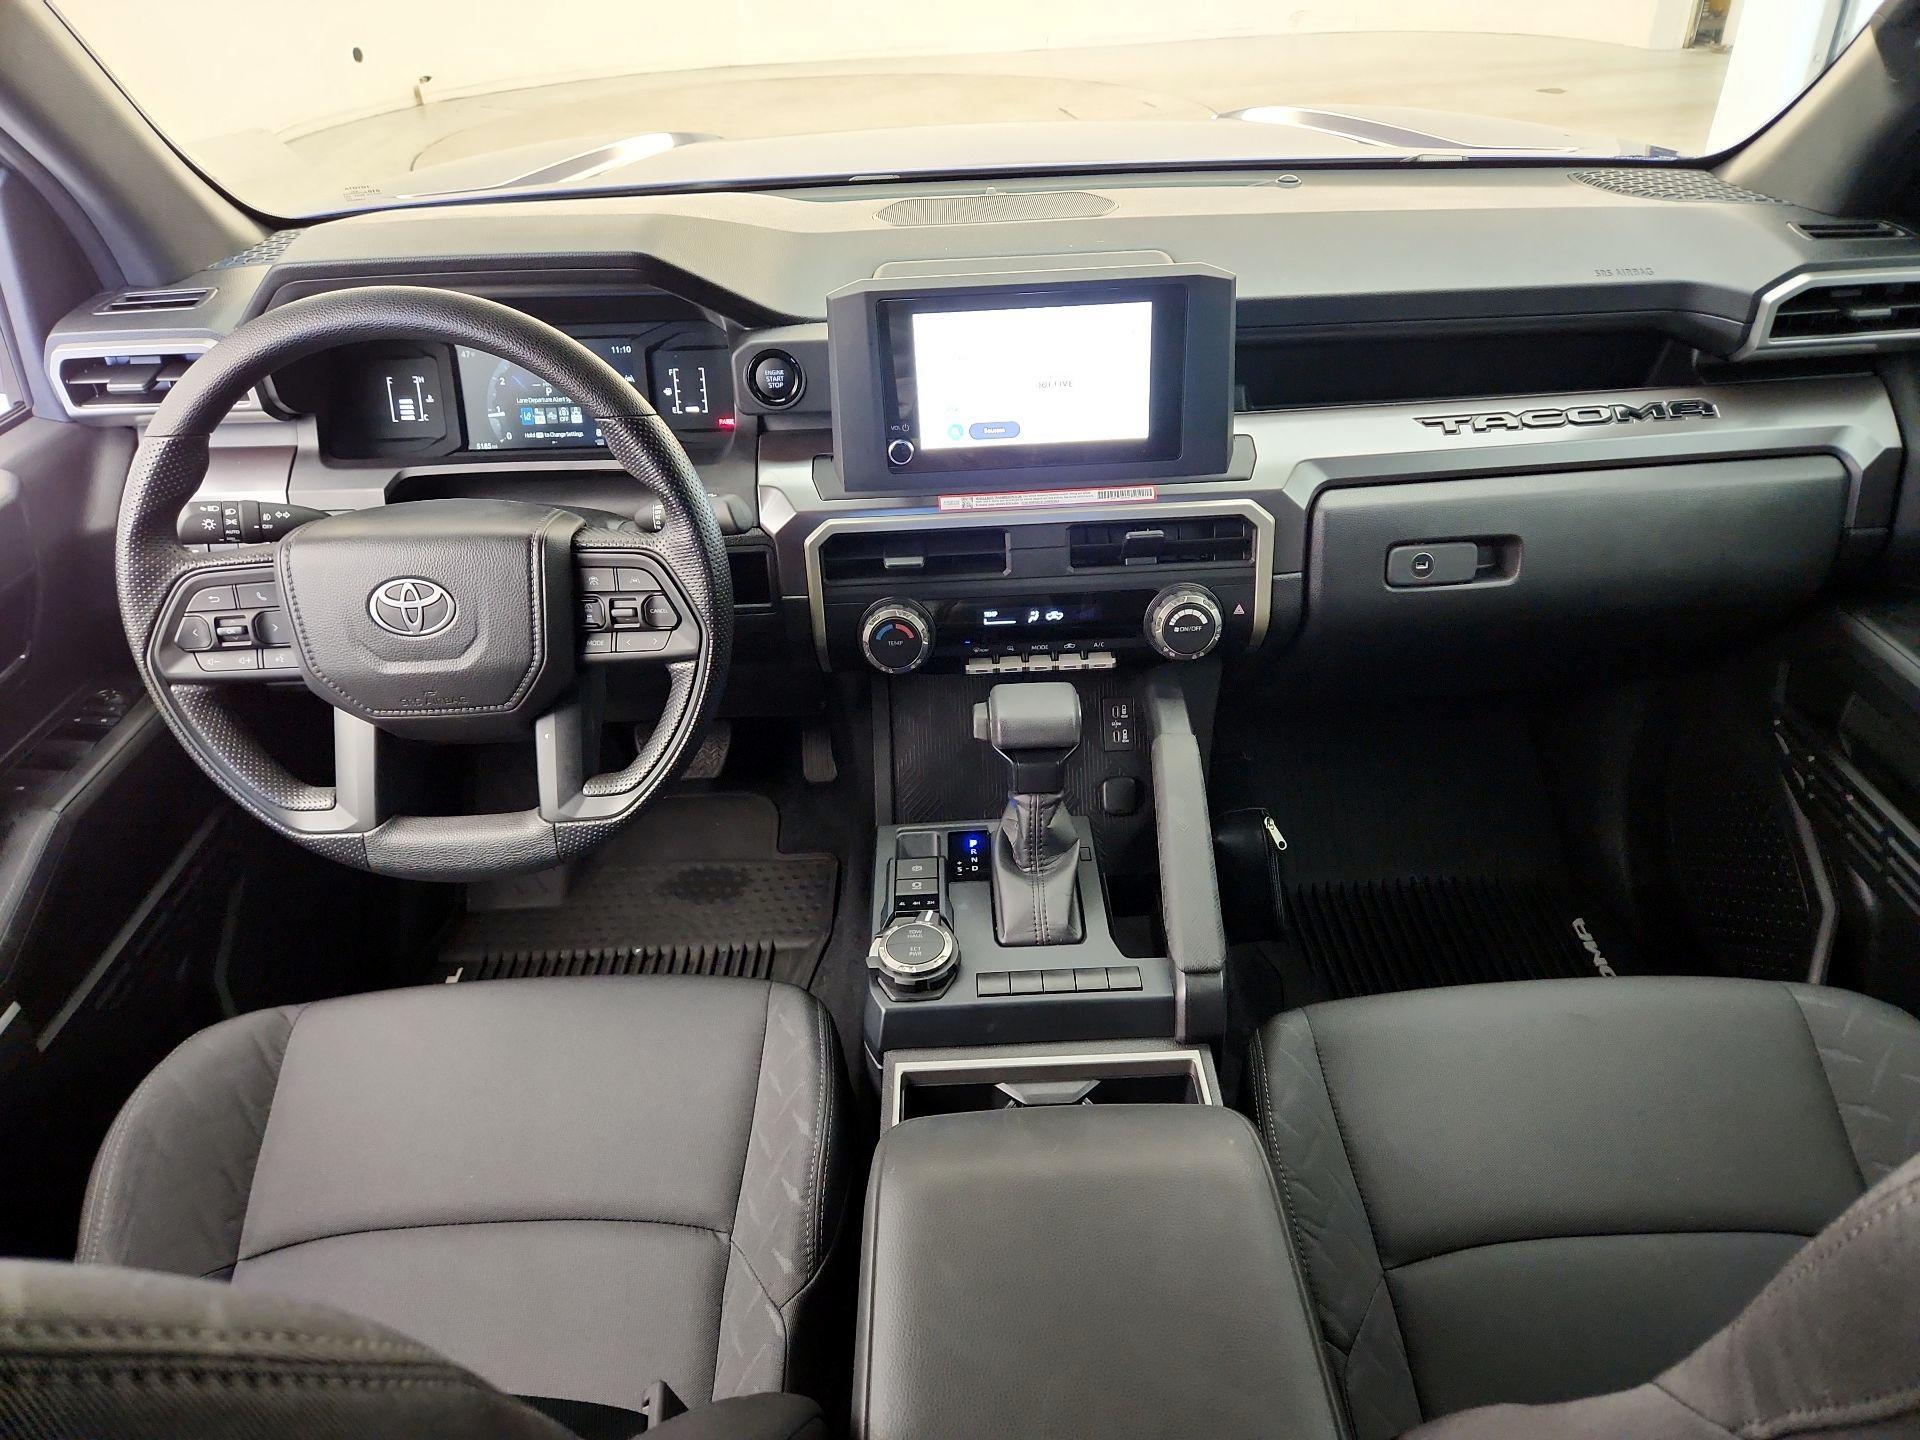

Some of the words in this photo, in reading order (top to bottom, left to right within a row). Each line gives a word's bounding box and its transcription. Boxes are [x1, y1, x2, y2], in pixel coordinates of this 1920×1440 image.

[611, 346, 632, 354] 11:10
[499, 377, 506, 386] 2
[545, 387, 552, 396] P
[528, 397, 552, 405] Departure
[1412, 399, 1721, 436] TACOMA
[506, 431, 513, 440] 0
[969, 839, 977, 848] P
